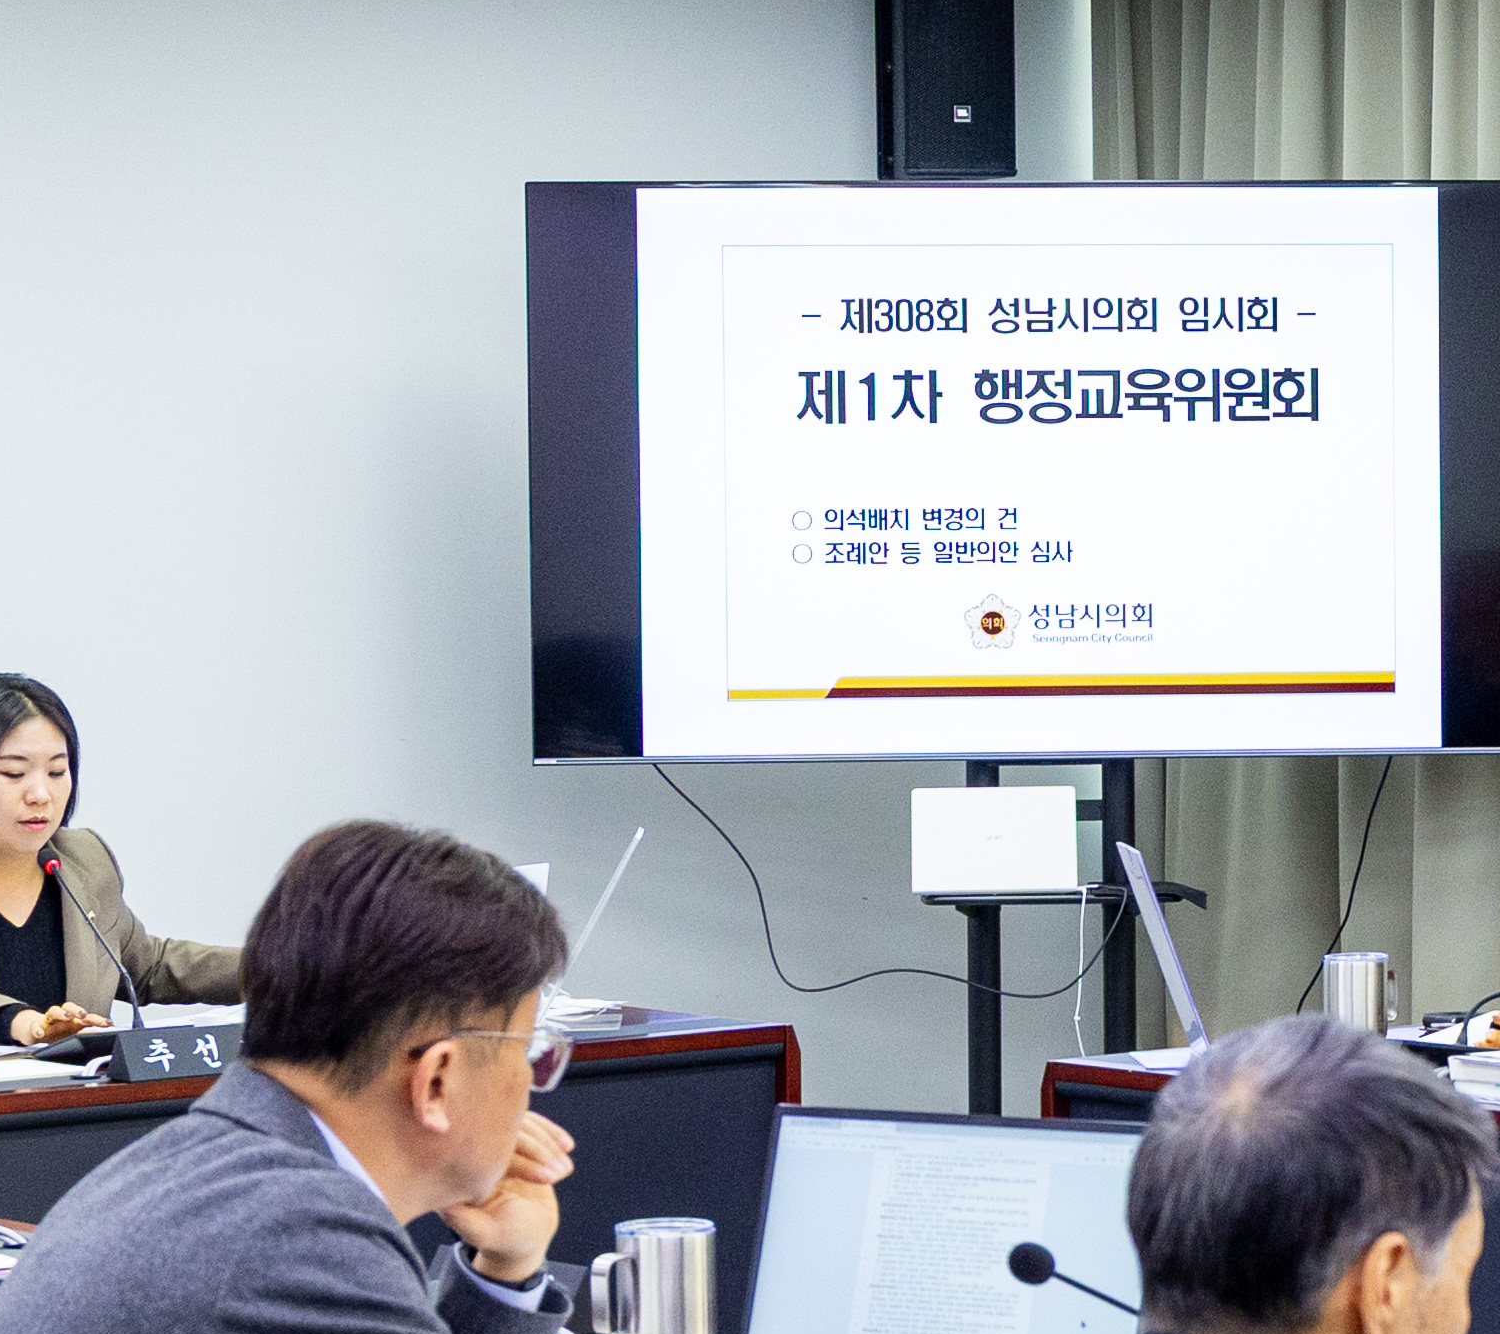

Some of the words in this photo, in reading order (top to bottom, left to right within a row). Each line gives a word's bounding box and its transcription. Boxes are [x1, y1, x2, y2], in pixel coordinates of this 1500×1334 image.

[839, 297, 968, 334] 제308회
[987, 297, 1158, 334] 성남시의회
[1178, 296, 1278, 333] 임시회
[797, 369, 943, 425] 제1차
[974, 368, 1319, 425] 행정교육위원회
[824, 508, 910, 531] 의석배치
[922, 508, 985, 531] 변경의
[998, 508, 1017, 530] 건
[825, 541, 889, 564] 조례안
[901, 542, 921, 564] 등
[933, 541, 1019, 564] 일반의안
[1031, 540, 1073, 563] 심사
[982, 618, 1004, 630] 의회
[1028, 603, 1153, 630] 성남시의회
[1032, 633, 1089, 644] Seongnam
[1091, 633, 1112, 644] City
[1114, 633, 1154, 643] Council
